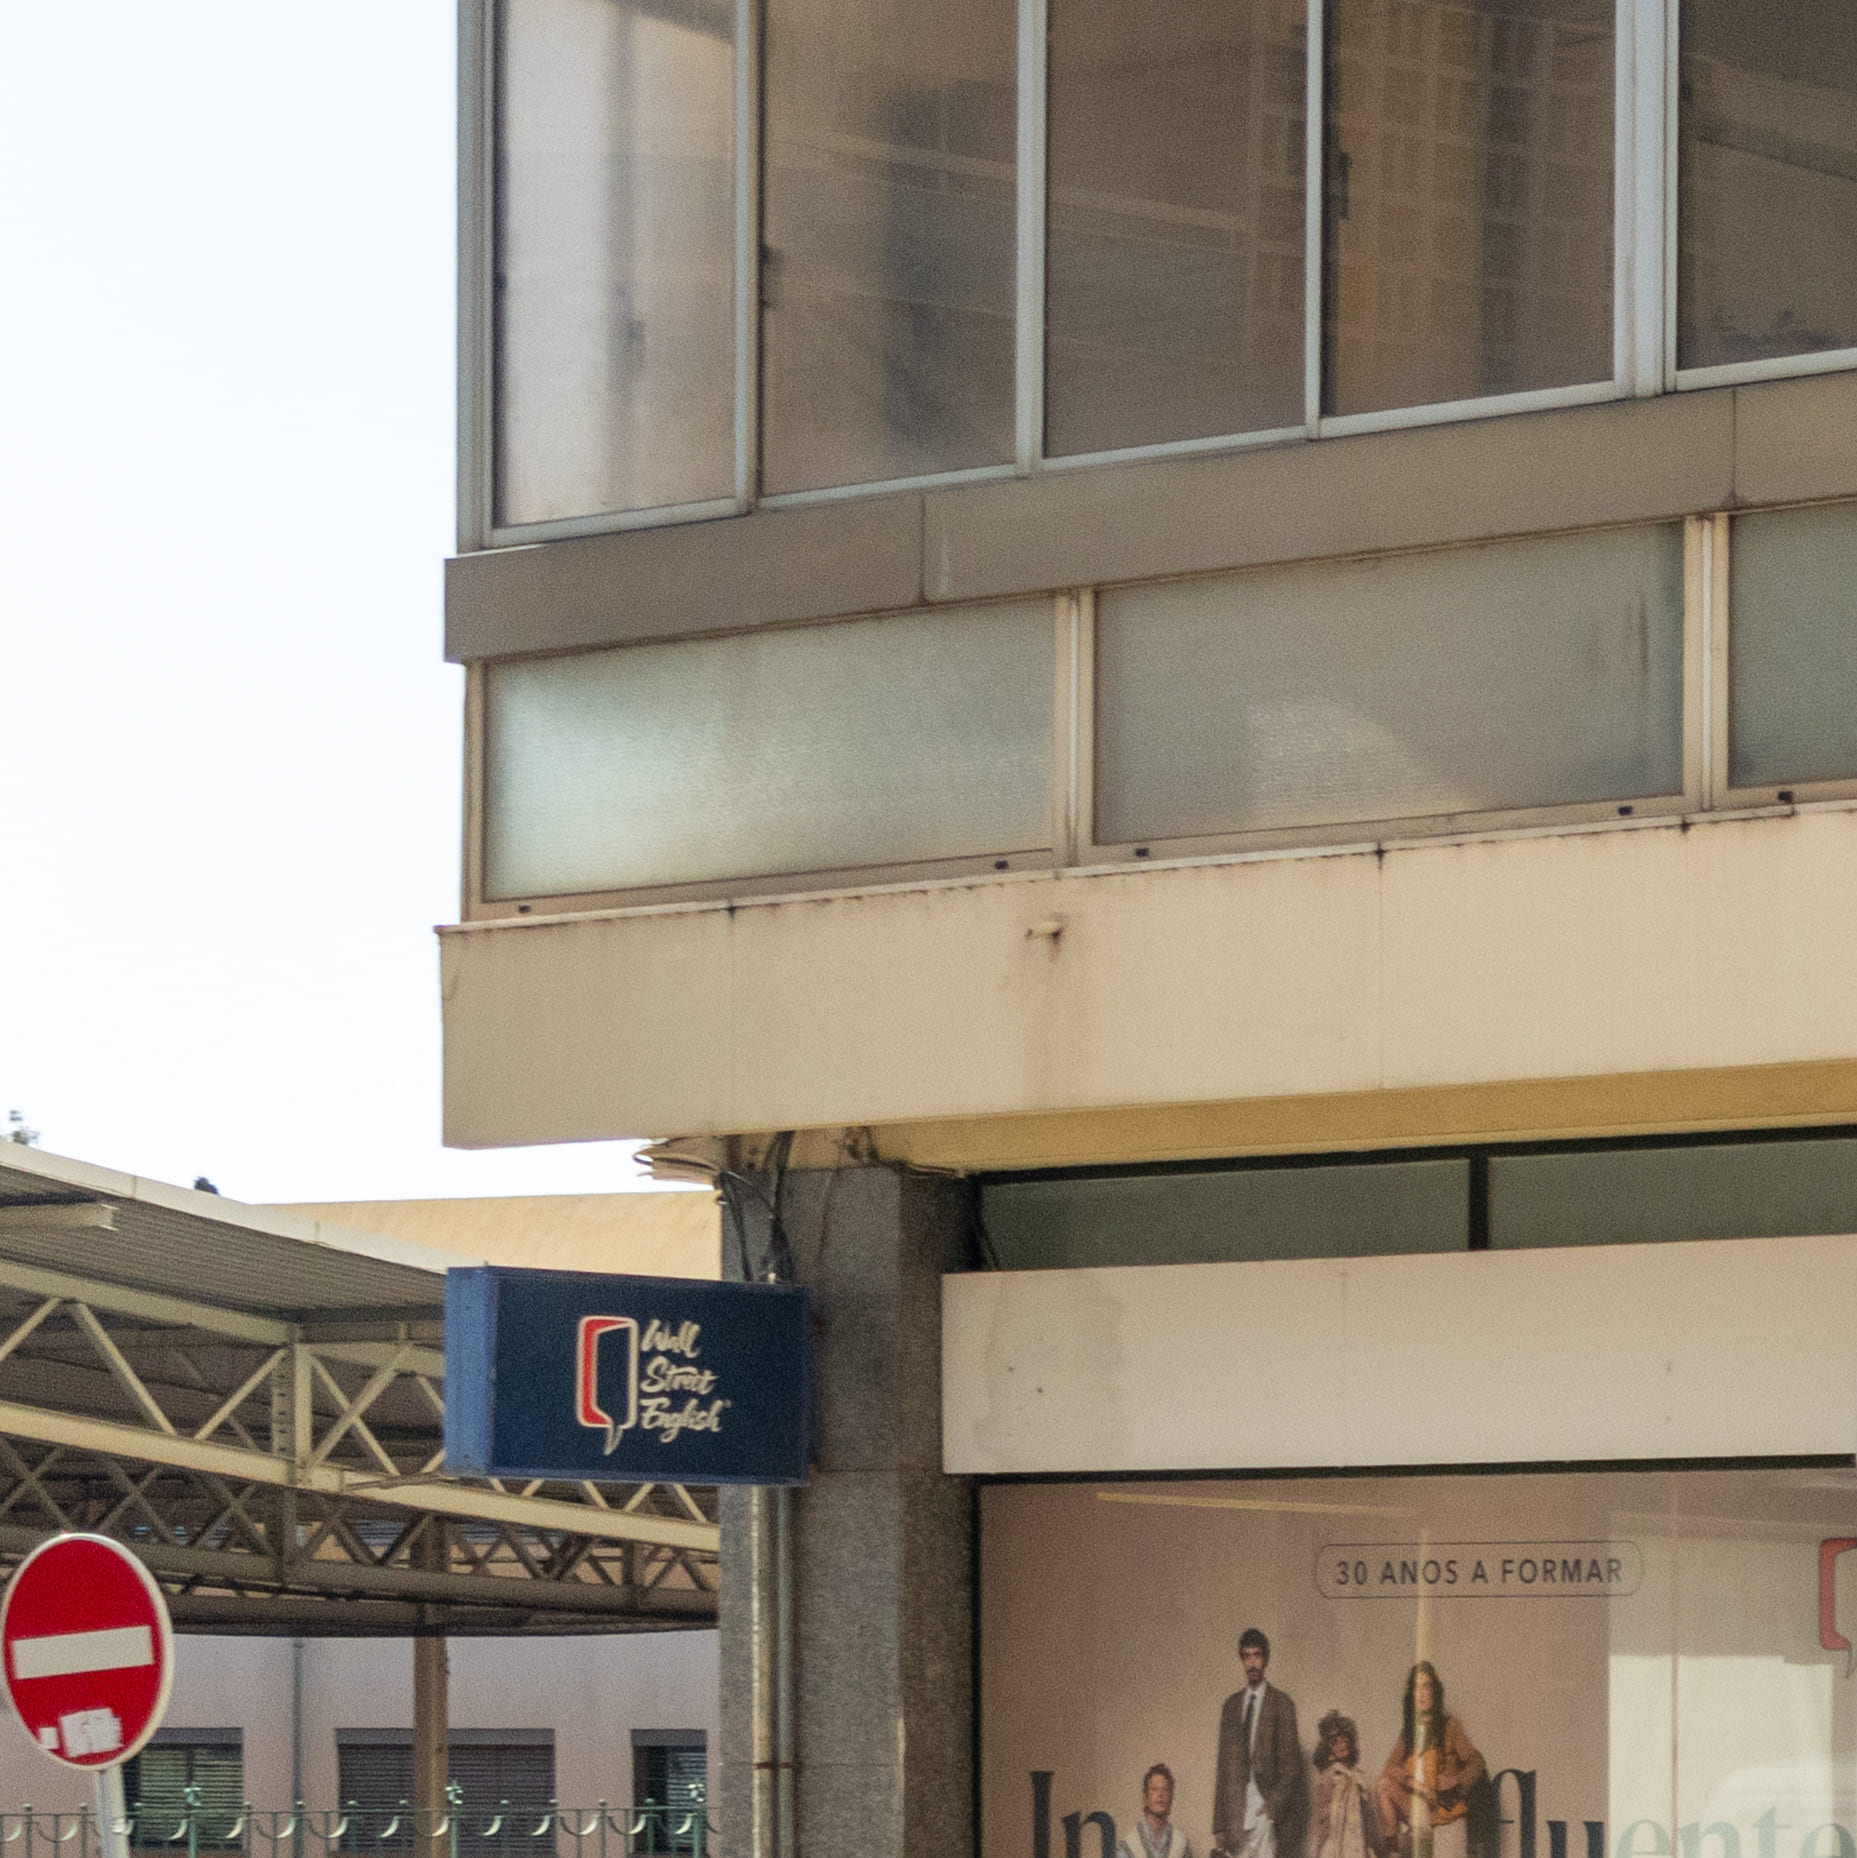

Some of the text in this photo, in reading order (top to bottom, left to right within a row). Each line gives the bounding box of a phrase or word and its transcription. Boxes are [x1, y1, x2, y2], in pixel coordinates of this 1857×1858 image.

[641, 1318, 702, 1359] Wall
[640, 1356, 720, 1396] Street
[1335, 1557, 1623, 1586] 30 ANOS A FORMAR
